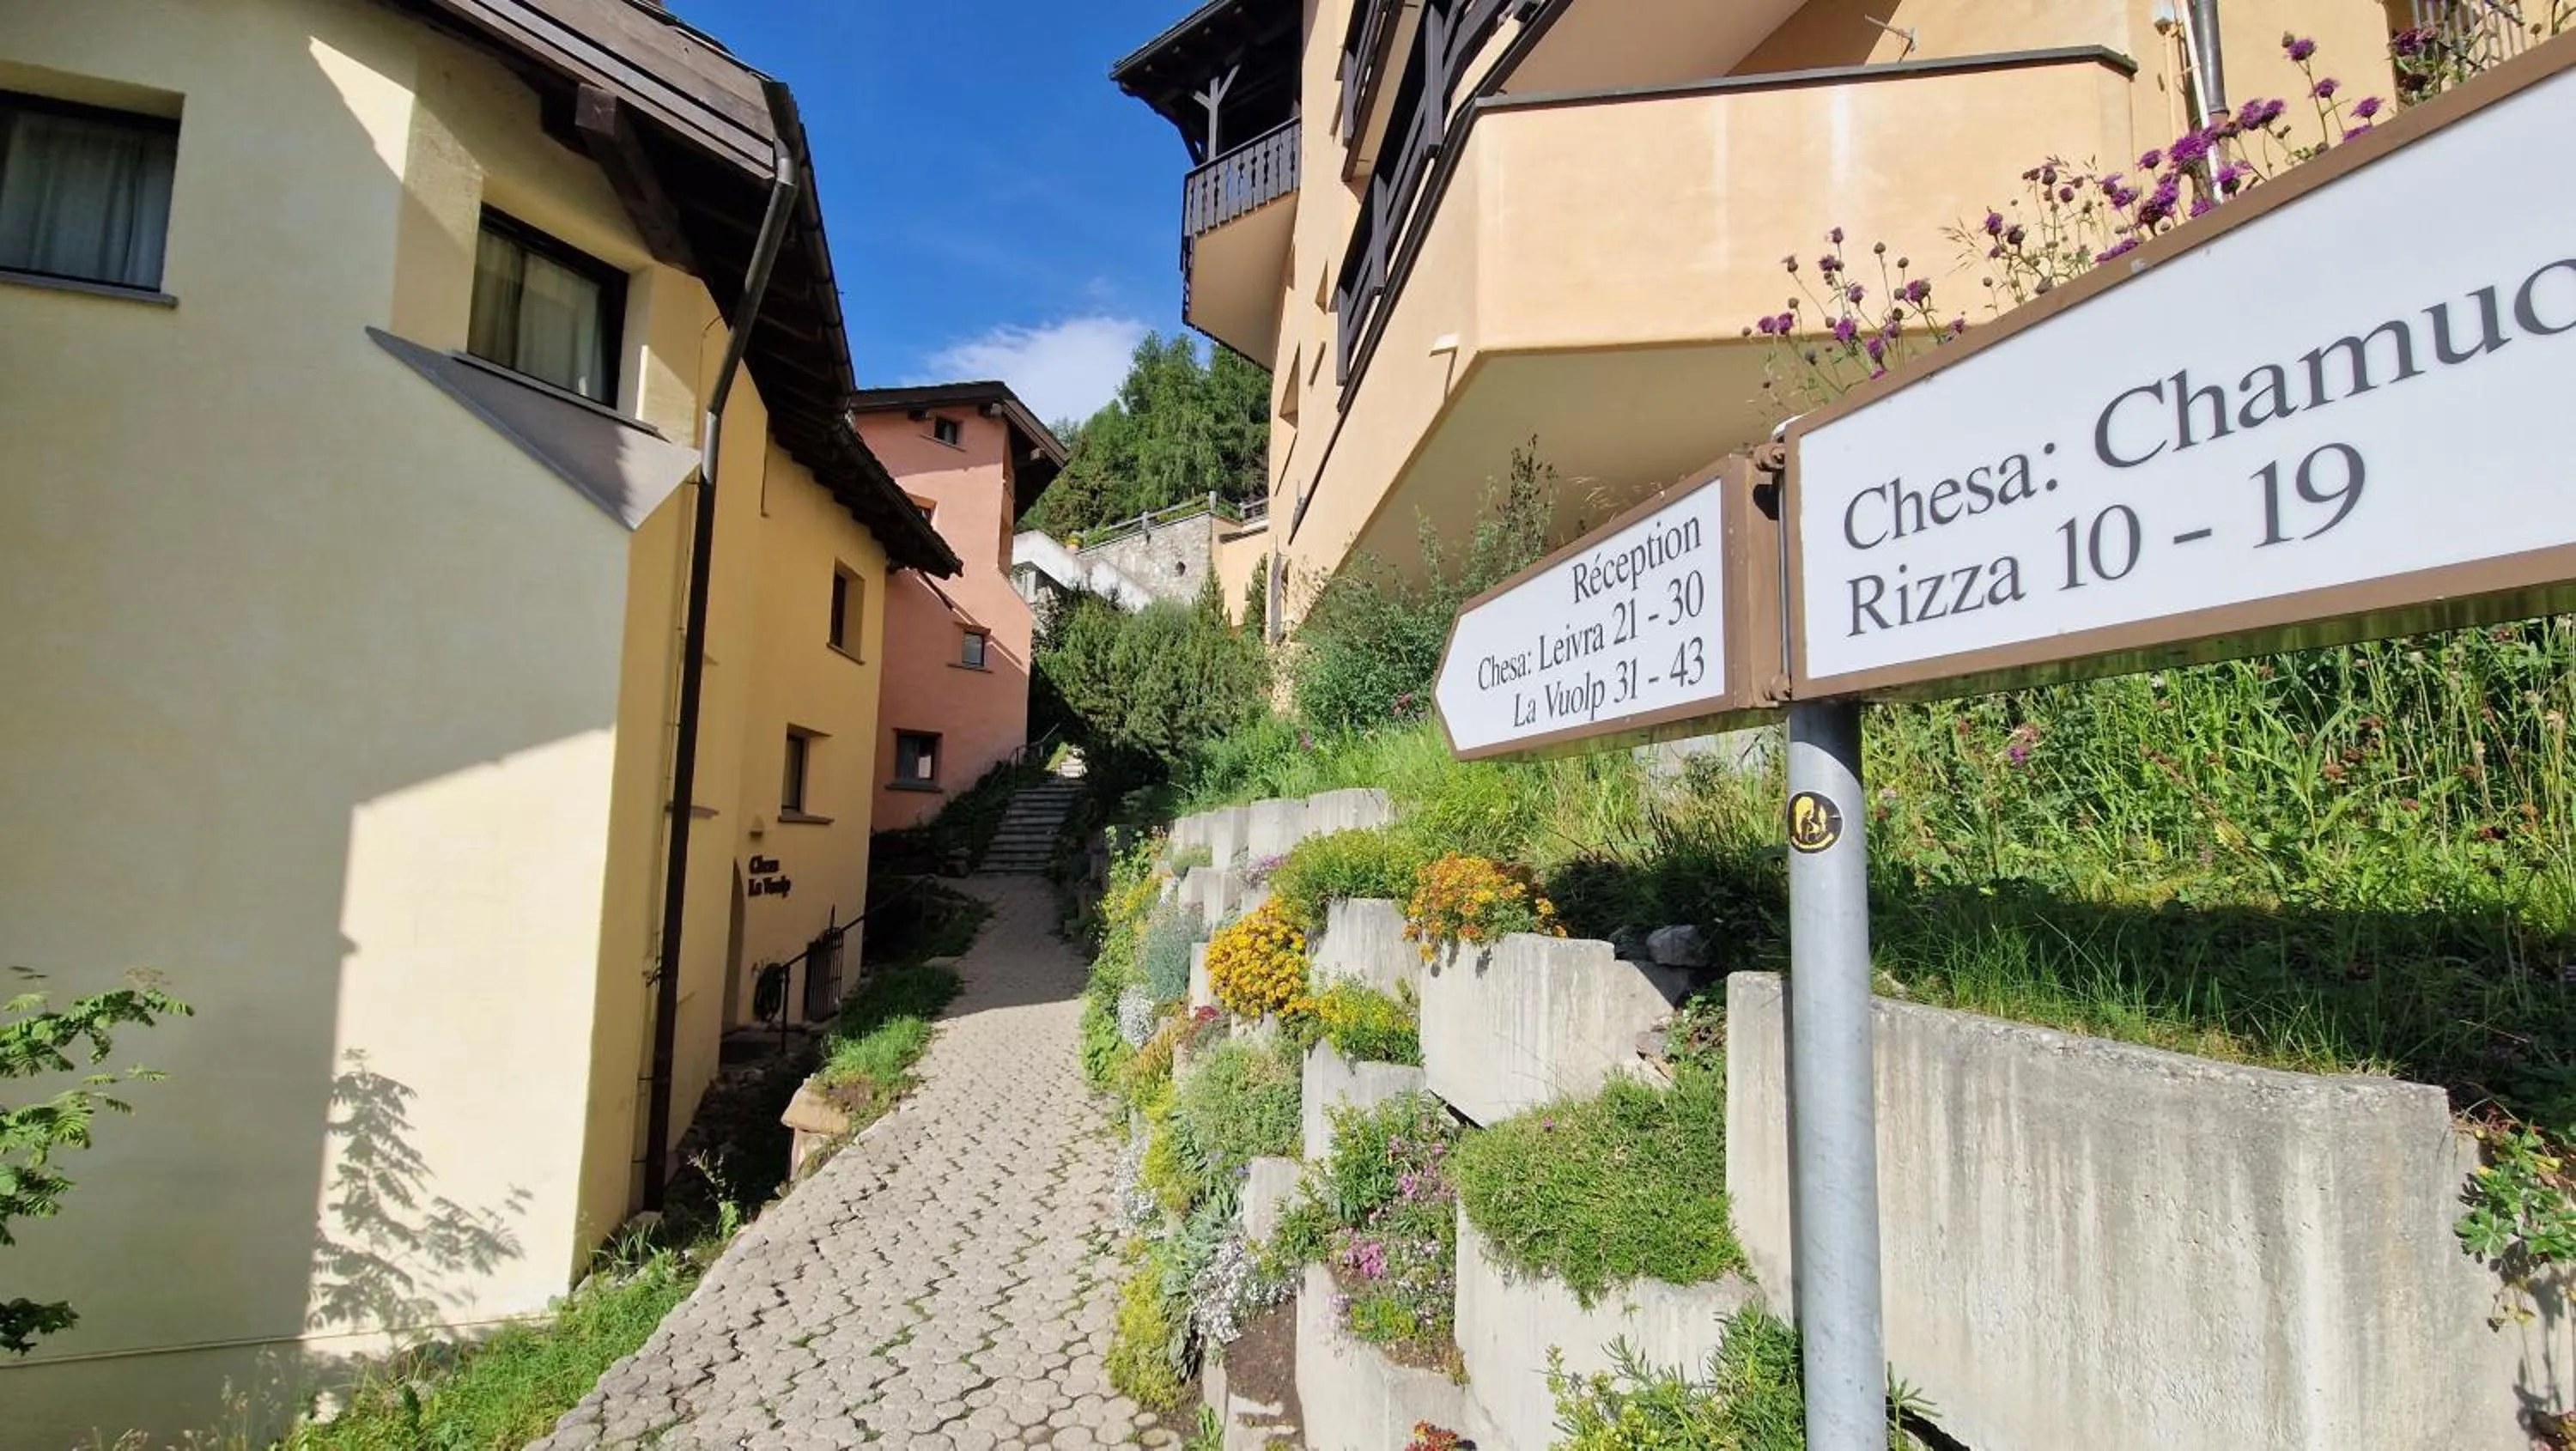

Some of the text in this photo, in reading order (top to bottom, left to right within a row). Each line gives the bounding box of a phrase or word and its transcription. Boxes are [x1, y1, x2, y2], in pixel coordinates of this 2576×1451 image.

[1844, 442, 2059, 550] Chesa:
[1847, 556, 2027, 637] Rizza
[2057, 504, 2142, 592] 10
[2250, 442, 2366, 549] 19
[1571, 517, 1702, 604] Réception
[1478, 651, 1533, 691] Chesa:
[1539, 623, 1605, 671] Leivra
[1613, 598, 1637, 646] 21
[1668, 569, 1704, 626] 30
[1513, 693, 1536, 727] La
[1545, 671, 1606, 722] Vuolp
[1613, 659, 1637, 704] 31
[1670, 636, 1705, 688] 43
